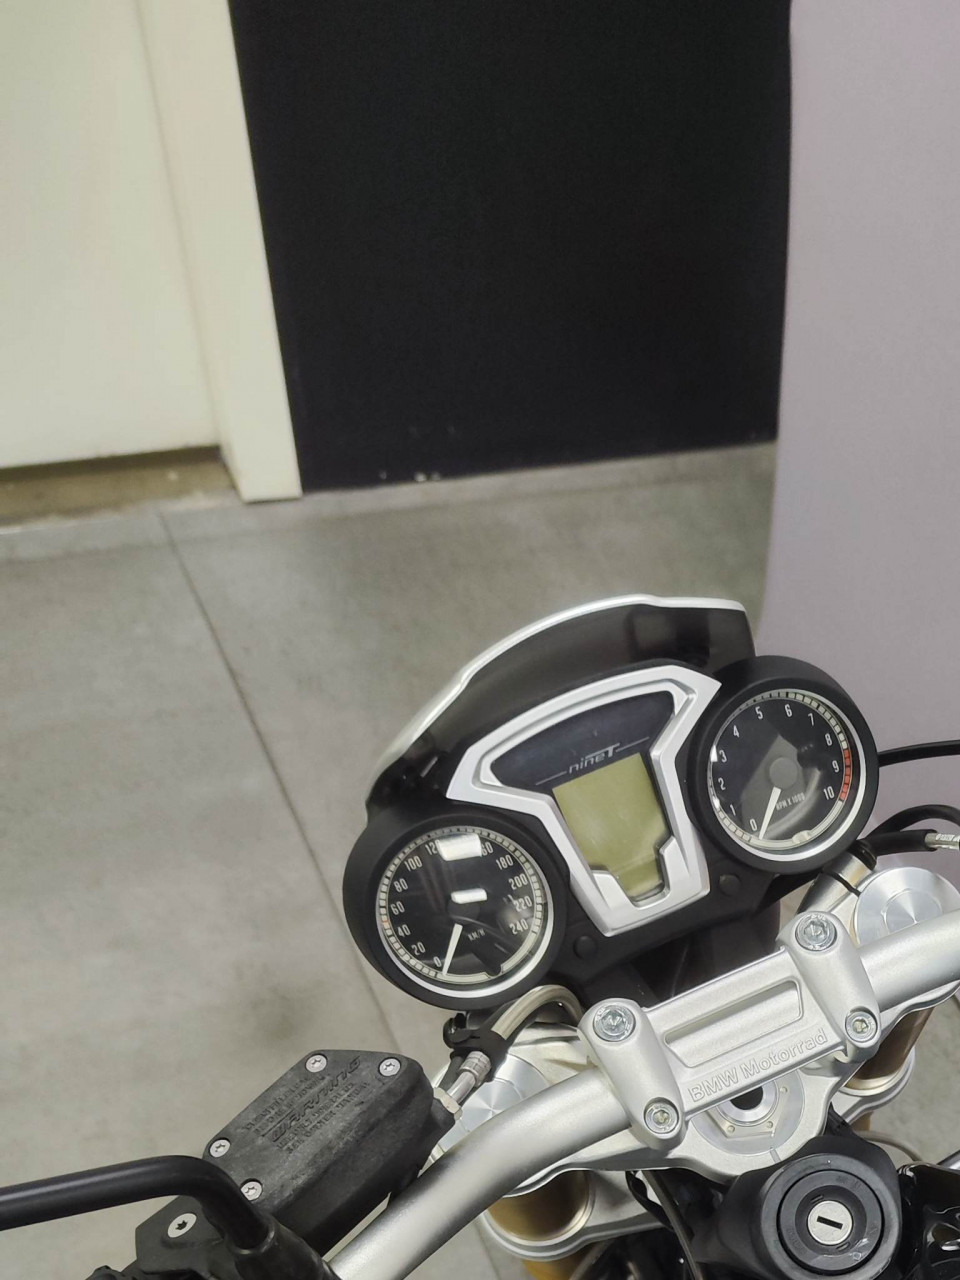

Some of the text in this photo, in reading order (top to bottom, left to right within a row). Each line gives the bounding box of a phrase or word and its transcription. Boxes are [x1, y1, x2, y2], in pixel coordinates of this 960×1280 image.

[755, 706, 763, 720] 5
[784, 704, 793, 718] 6
[807, 713, 815, 726] 7
[732, 725, 740, 738] 4
[824, 733, 833, 746] 8
[569, 742, 620, 774] nineT
[719, 750, 728, 763] 3
[832, 760, 840, 773] 9
[718, 777, 726, 791] 2
[823, 786, 835, 800] 10
[729, 804, 736, 816] 1
[750, 818, 758, 831] 0
[404, 855, 423, 872] 100
[495, 854, 514, 870] 180
[393, 878, 409, 893] 80
[508, 873, 528, 890] 200
[390, 901, 406, 916] 60
[513, 895, 533, 912] 220
[397, 924, 411, 938] 40
[509, 918, 529, 935] 240
[411, 941, 426, 956] 20
[433, 956, 442, 968] 0
[688, 1027, 828, 1103] BMW Motorrad
